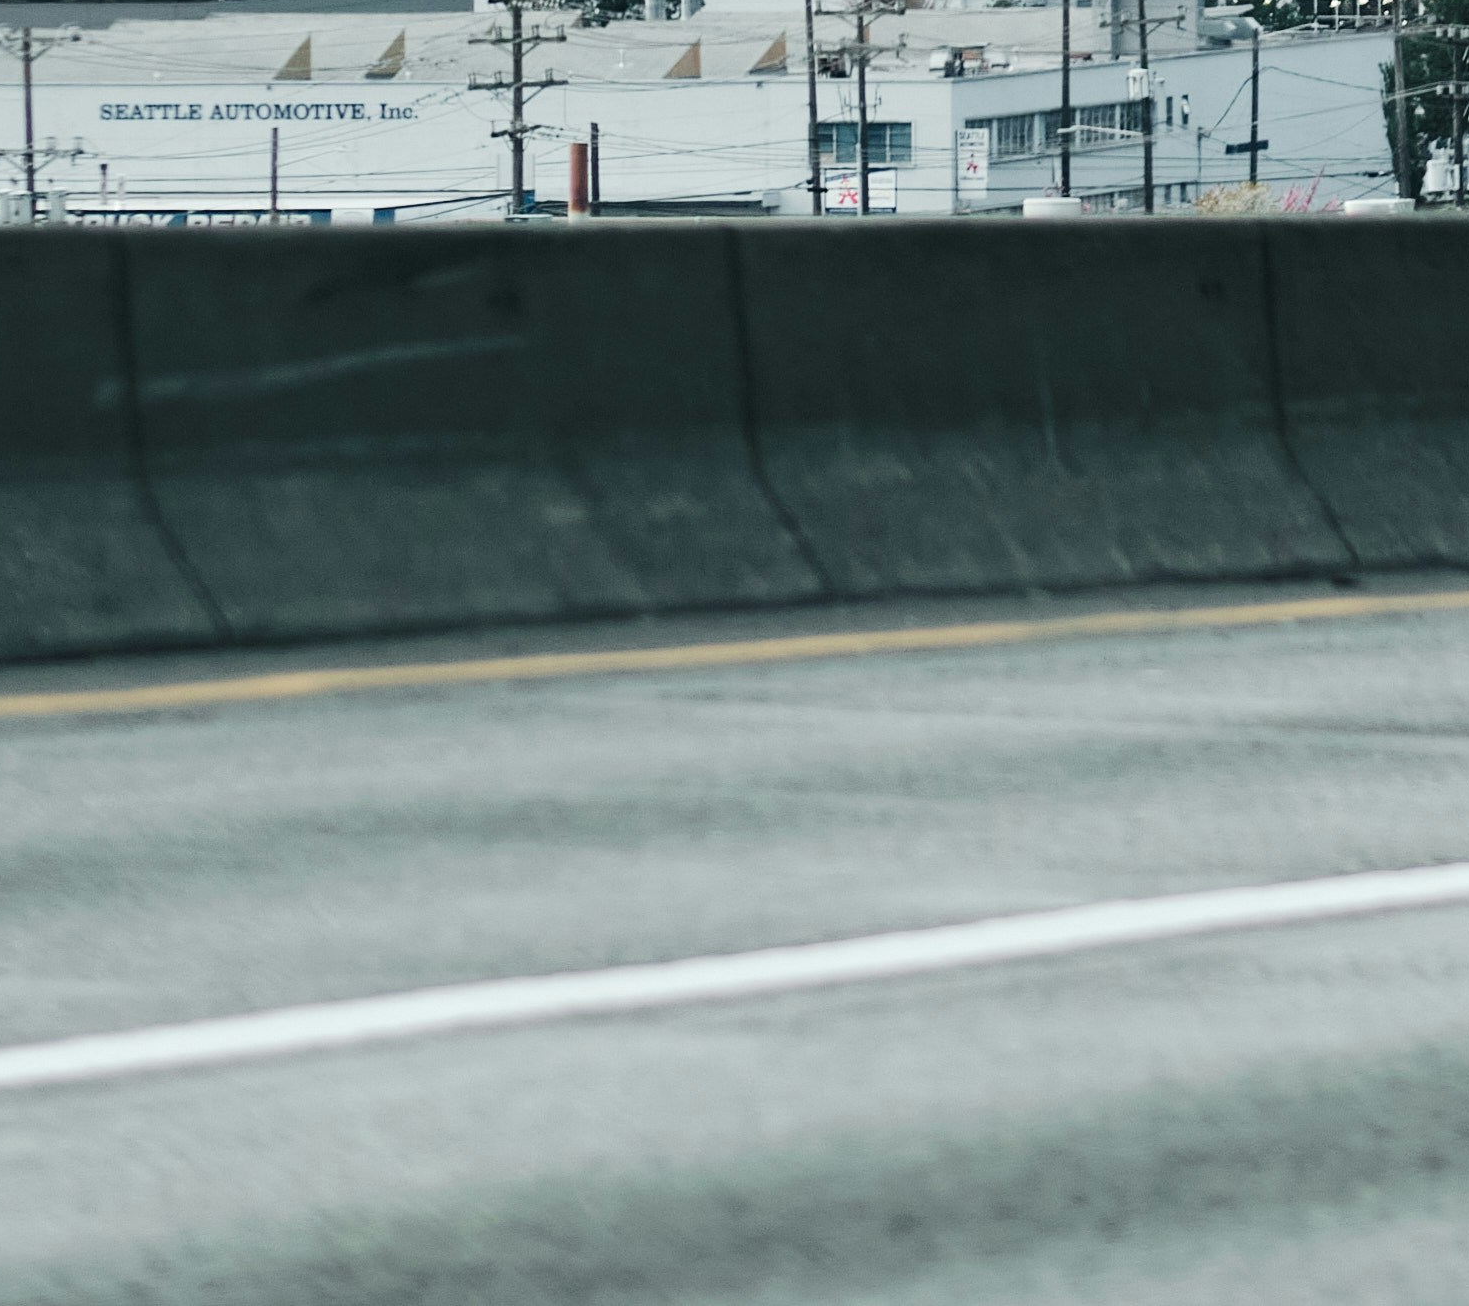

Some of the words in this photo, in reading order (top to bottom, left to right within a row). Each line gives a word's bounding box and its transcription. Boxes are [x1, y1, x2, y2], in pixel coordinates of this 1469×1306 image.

[99, 103, 202, 120] SEATTLE
[209, 103, 371, 122] AUTOMOTIVE,
[378, 103, 419, 120] Inc.
